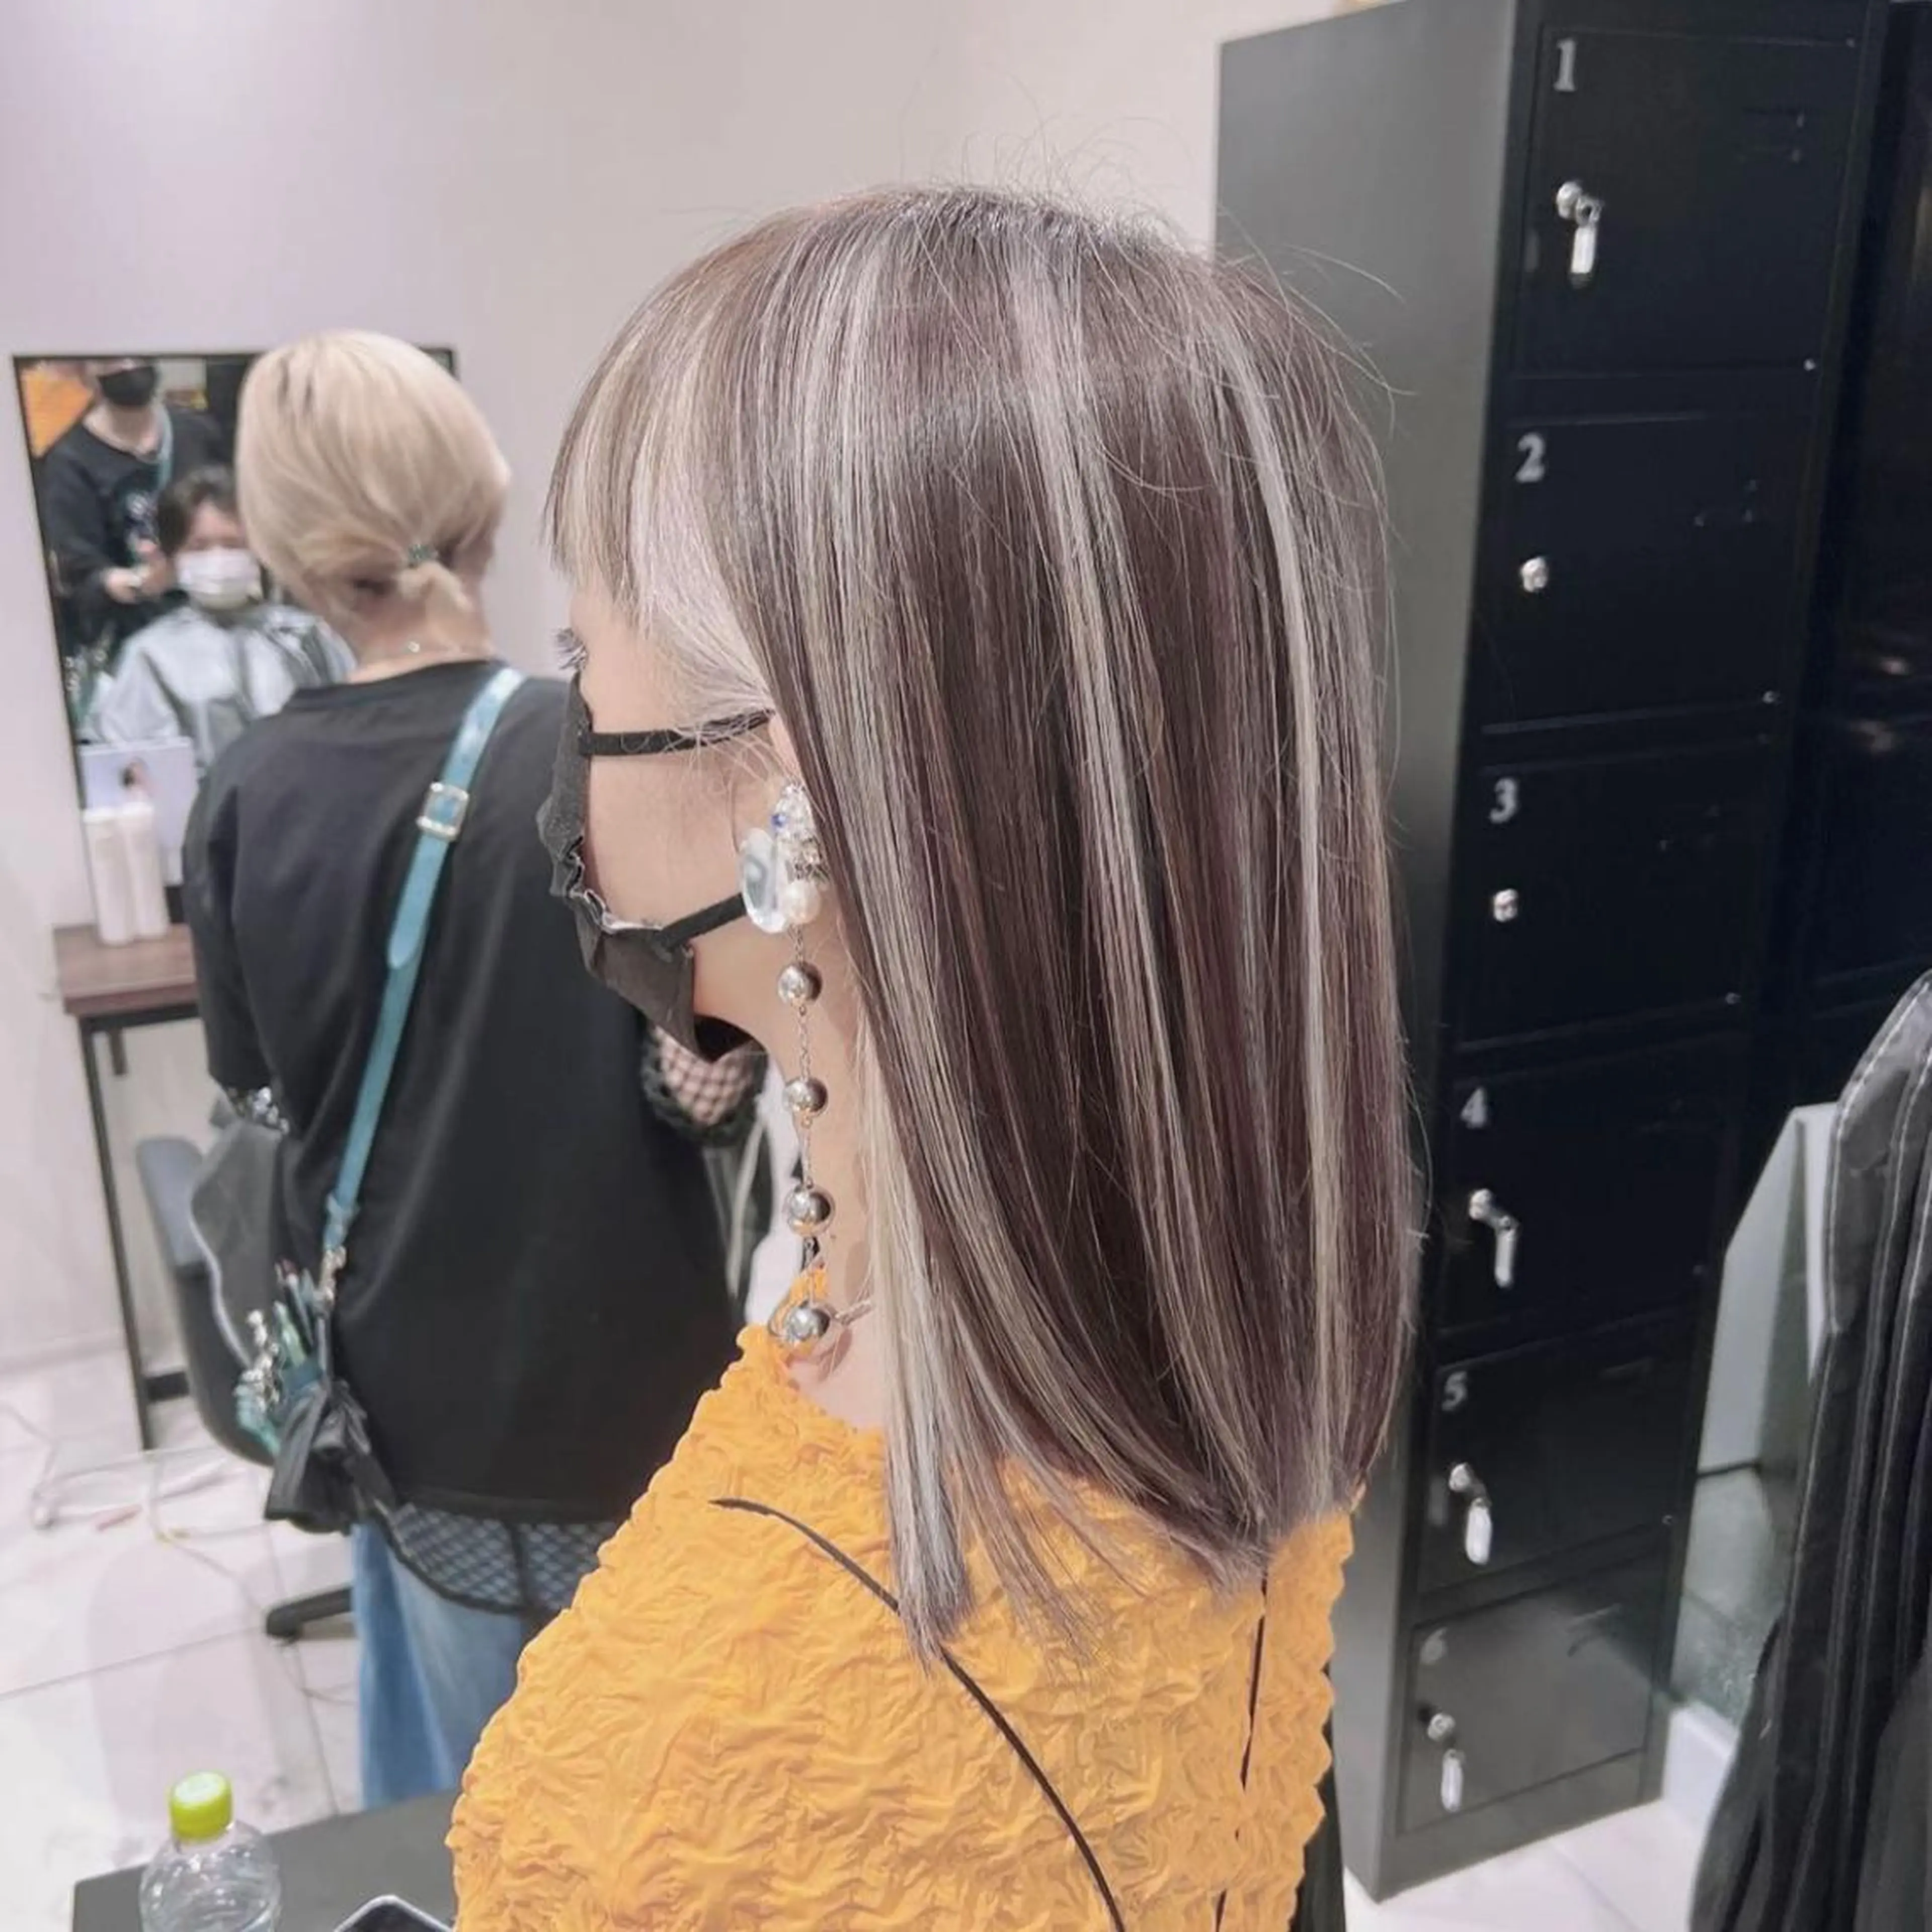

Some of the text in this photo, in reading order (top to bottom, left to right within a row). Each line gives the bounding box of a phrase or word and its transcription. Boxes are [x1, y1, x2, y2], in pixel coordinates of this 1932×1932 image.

[1554, 38, 1577, 92] 1
[1516, 433, 1545, 483] 2
[1490, 778, 1517, 823] 3
[1461, 1088, 1487, 1128] 4
[1442, 1371, 1467, 1410] 5
